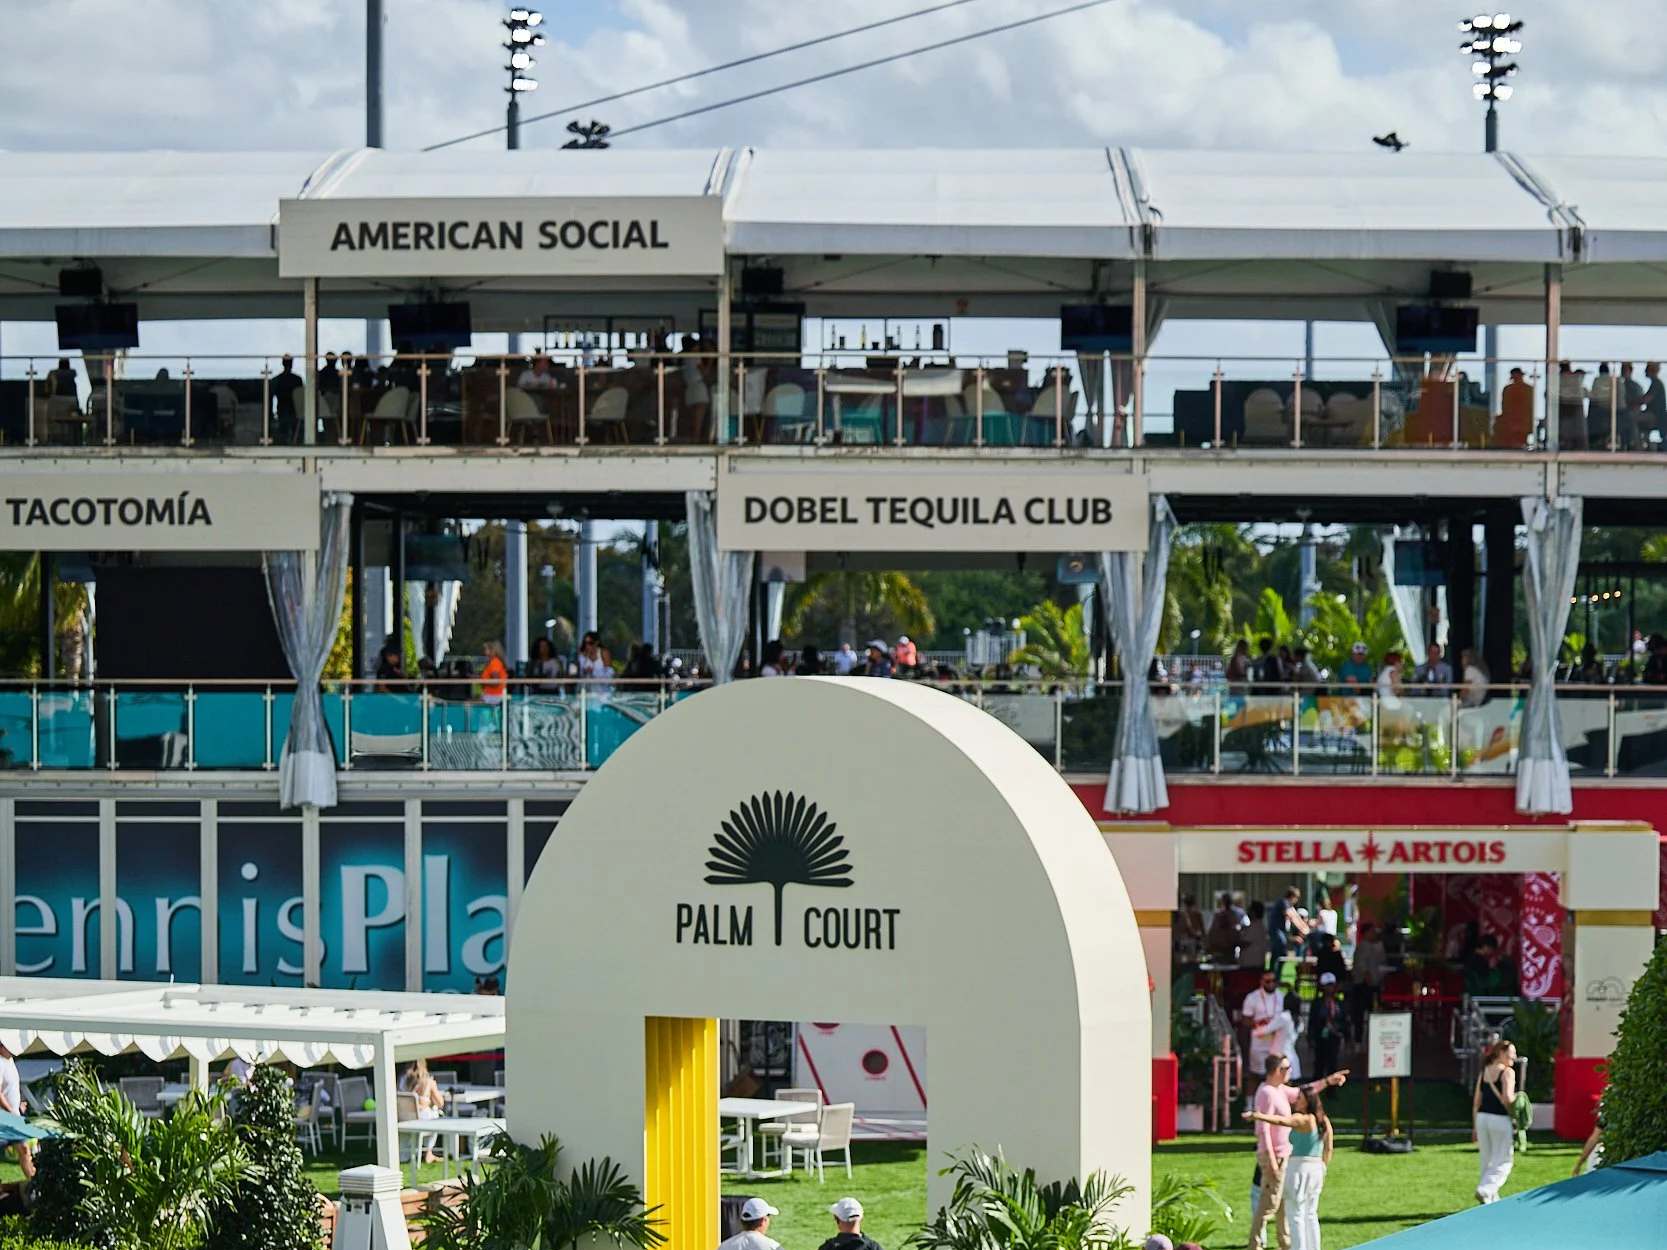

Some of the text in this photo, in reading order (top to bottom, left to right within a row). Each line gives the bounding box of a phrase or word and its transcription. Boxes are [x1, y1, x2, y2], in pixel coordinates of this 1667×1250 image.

[331, 219, 669, 251] AMERICAN SOCIAL
[6, 490, 212, 526] TACOTOMÍA
[745, 497, 1112, 529] DOBEL TEQUILA CLUB
[1238, 840, 1507, 864] STELLA ARTOIS
[677, 903, 901, 950] PALM COURT
